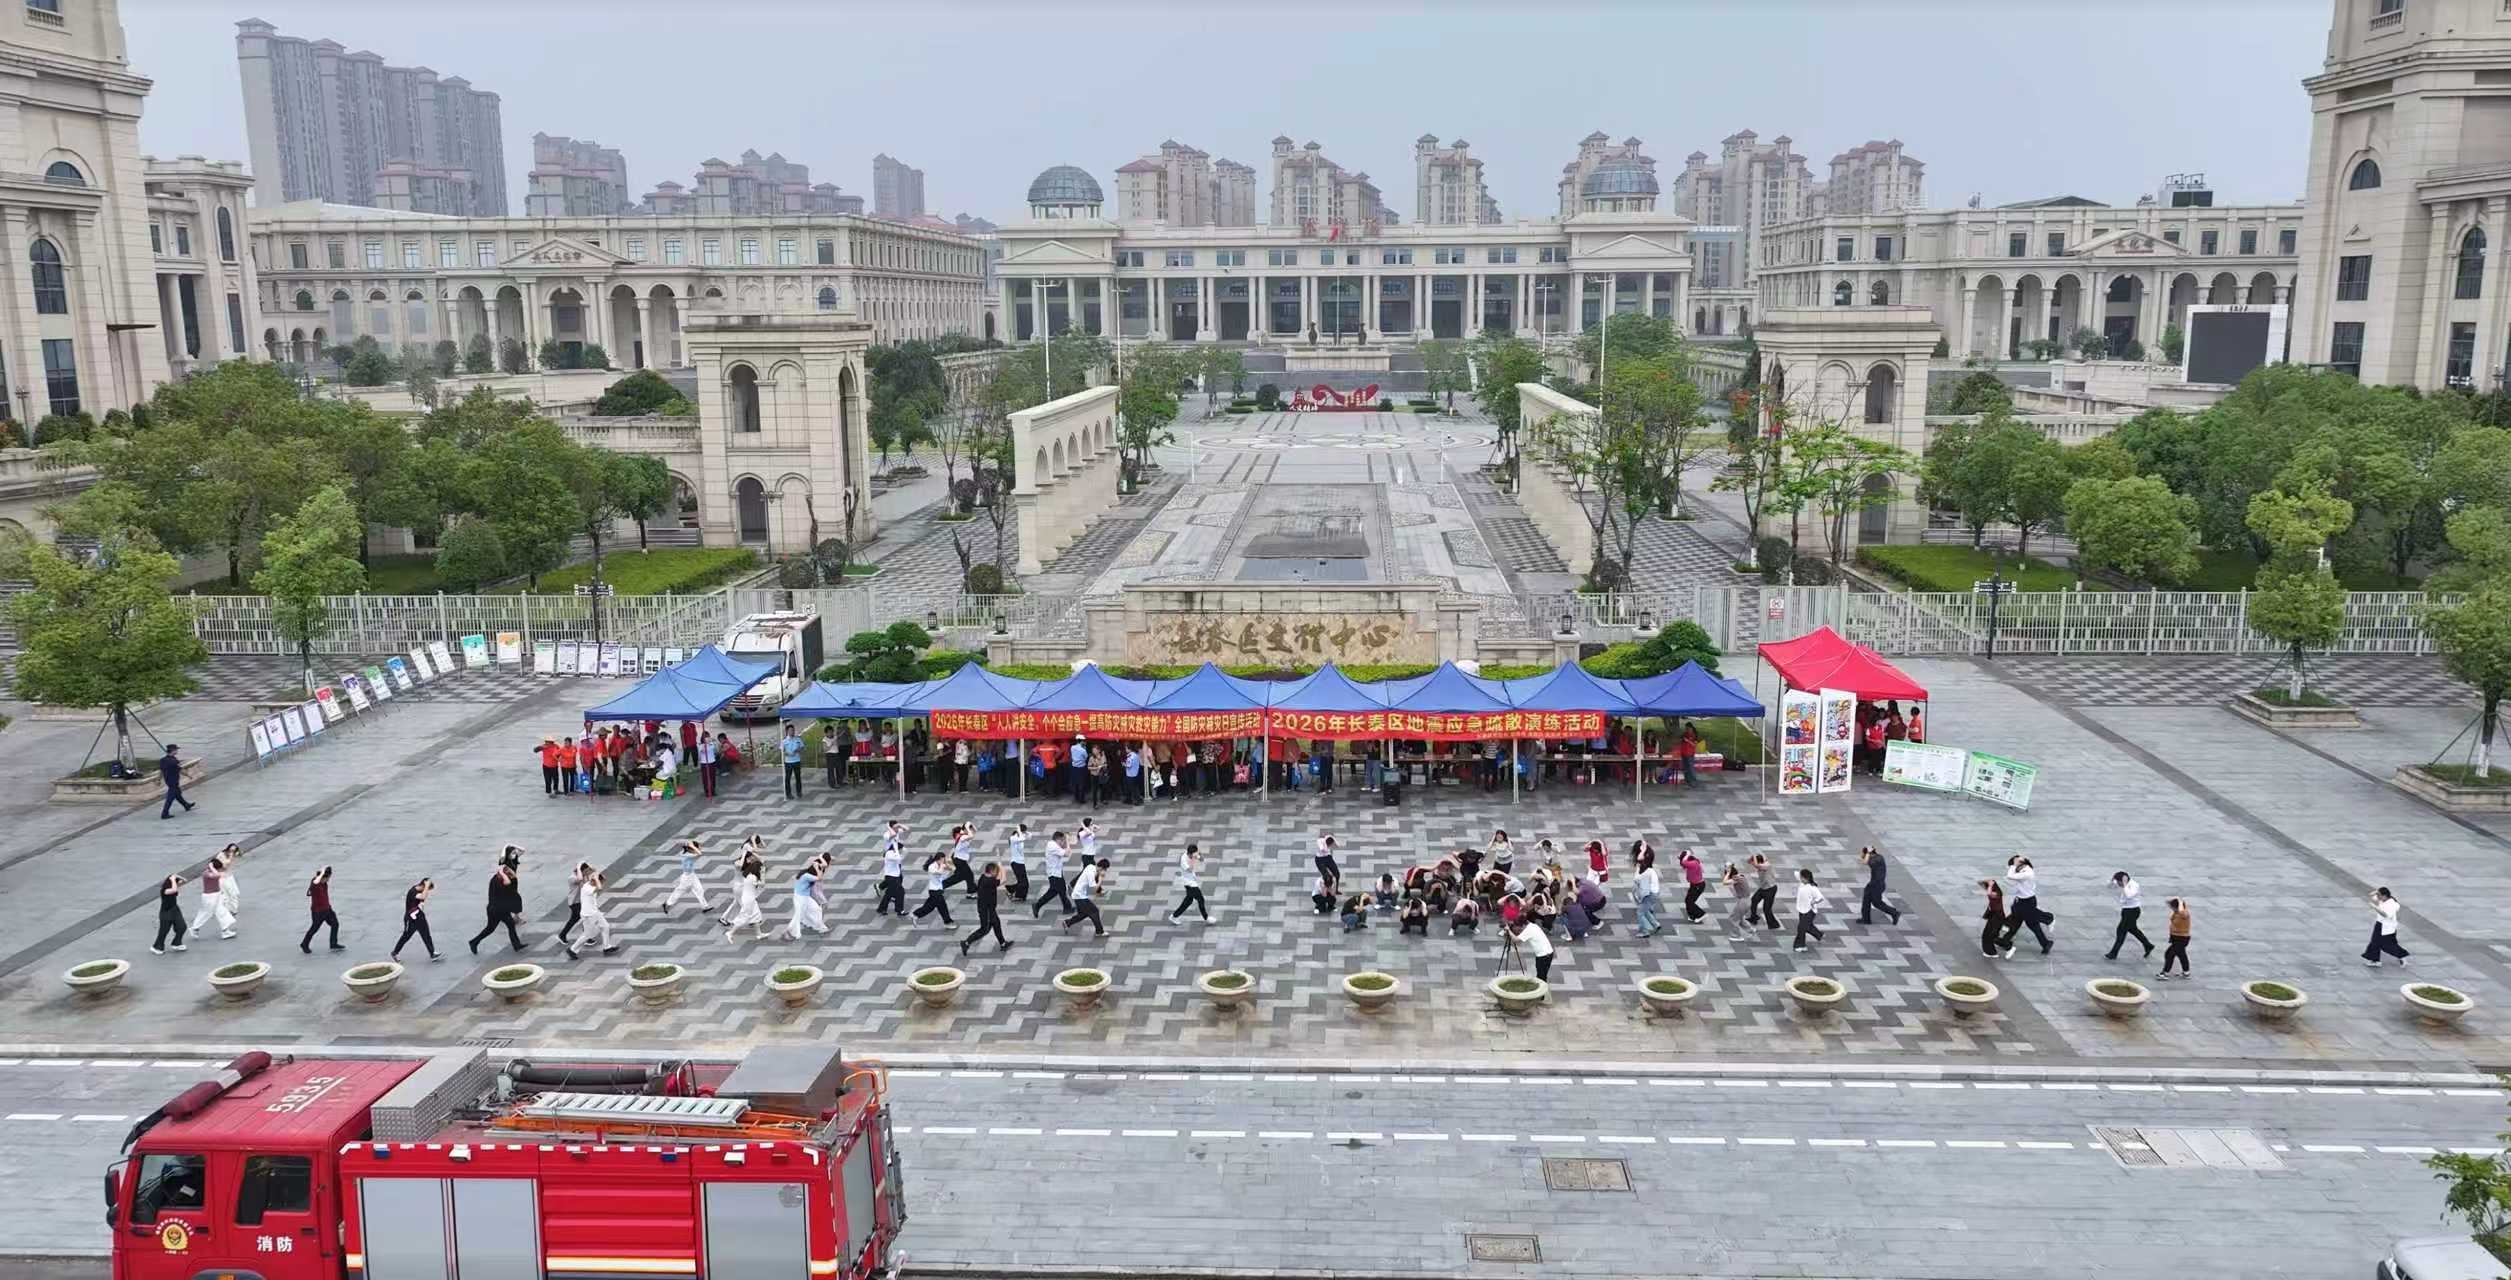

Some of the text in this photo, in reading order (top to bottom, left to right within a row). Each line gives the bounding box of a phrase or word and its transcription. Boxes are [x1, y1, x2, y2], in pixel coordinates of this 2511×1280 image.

[1272, 712, 1600, 734] 2026年长泰区地震应急疏散演练活动
[265, 1076, 335, 1112] 5935
[256, 1235, 293, 1253] 消防
